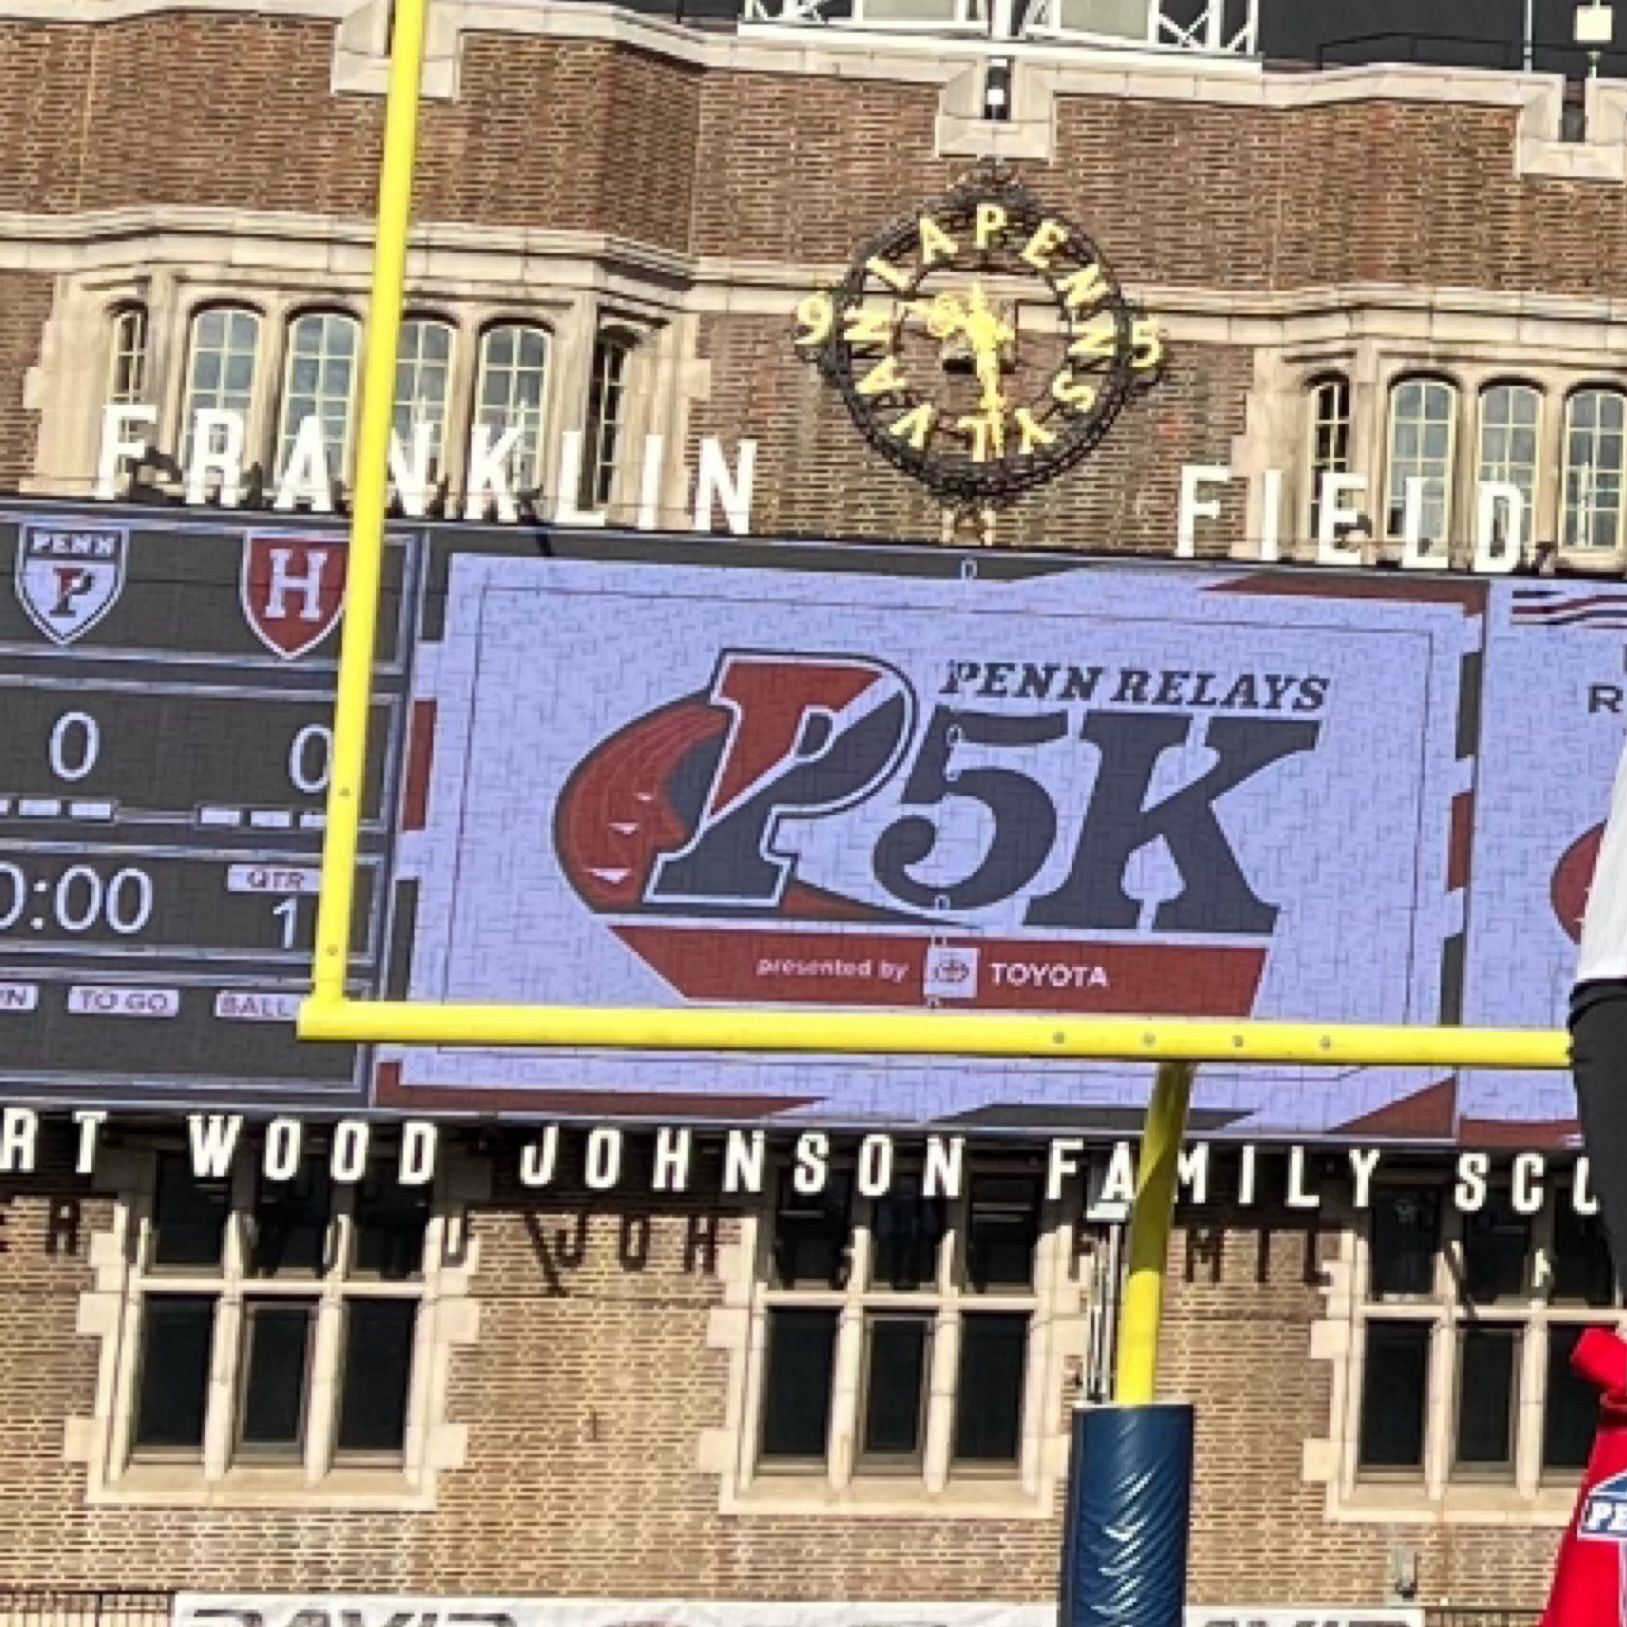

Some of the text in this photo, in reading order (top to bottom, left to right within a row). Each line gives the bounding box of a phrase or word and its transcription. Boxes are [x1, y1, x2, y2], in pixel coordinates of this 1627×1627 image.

[94, 403, 758, 534] FRANKLIN
[30, 532, 117, 556] PENN
[1173, 463, 1526, 574] FIELD
[265, 548, 328, 622] H
[939, 659, 1331, 712] PENN RELAYS
[50, 712, 100, 782] 0
[290, 725, 334, 793] 0
[246, 869, 306, 889] QTR
[272, 896, 298, 949] 1
[755, 958, 1110, 988] presented by TOYOTA
[81, 990, 169, 1011] TO GO
[219, 994, 291, 1017] BALL
[187, 1113, 439, 1186] WOOD
[519, 1125, 966, 1199] JOHNSON
[1046, 1138, 1382, 1208] FAMILY
